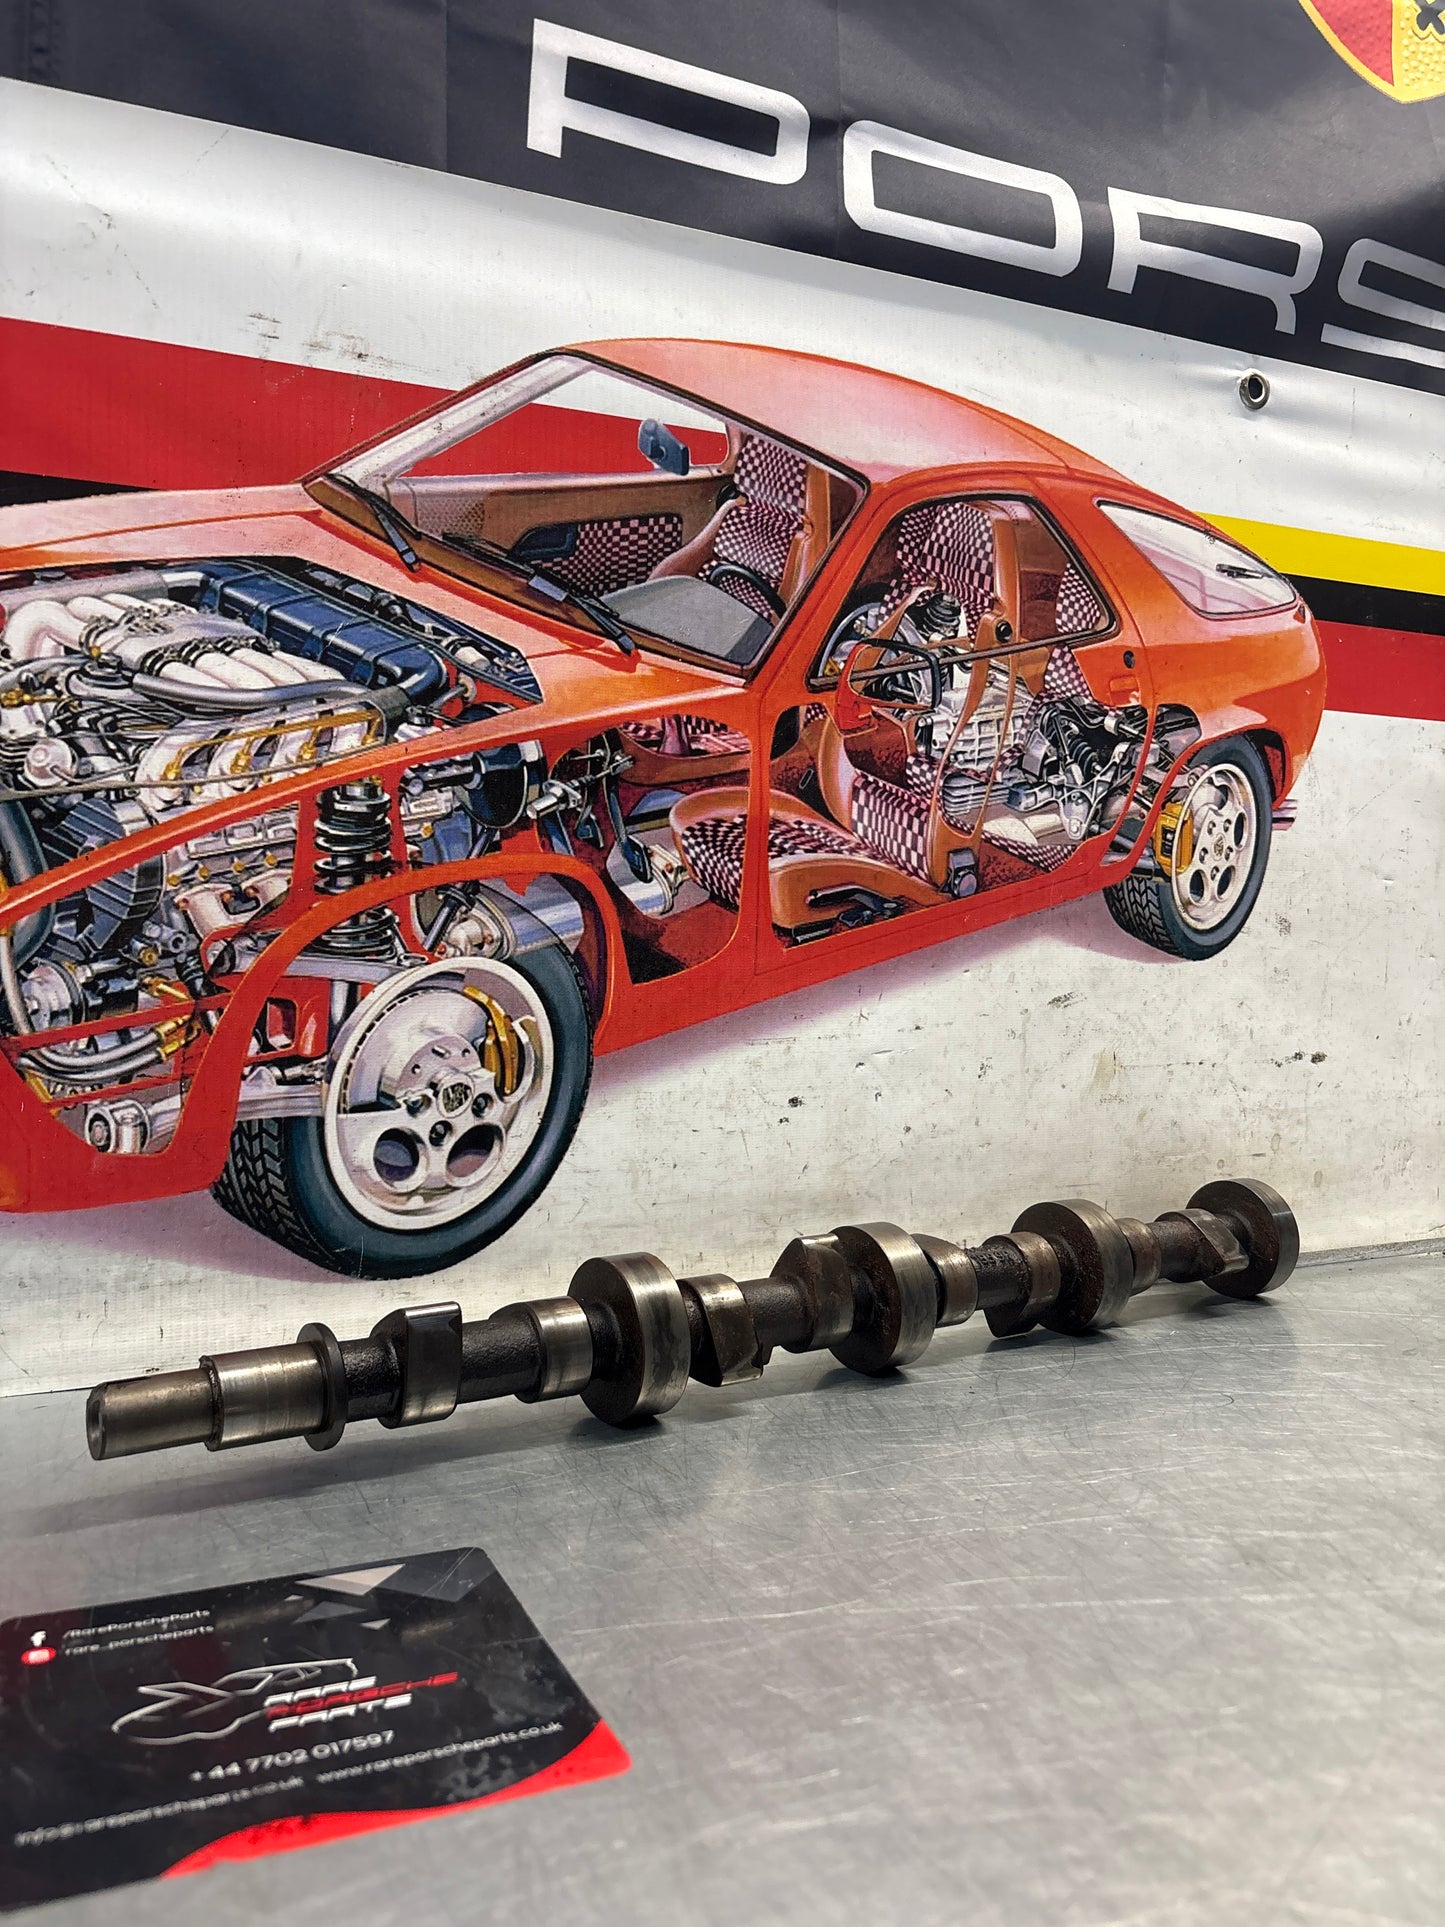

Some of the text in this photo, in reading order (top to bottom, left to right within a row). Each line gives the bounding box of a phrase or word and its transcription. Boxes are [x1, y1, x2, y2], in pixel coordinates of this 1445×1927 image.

[264, 1676, 378, 1707] RARE
[268, 1692, 413, 1733] PARTS
[245, 1748, 309, 1773] 7702
[311, 1730, 395, 1759] 017597
